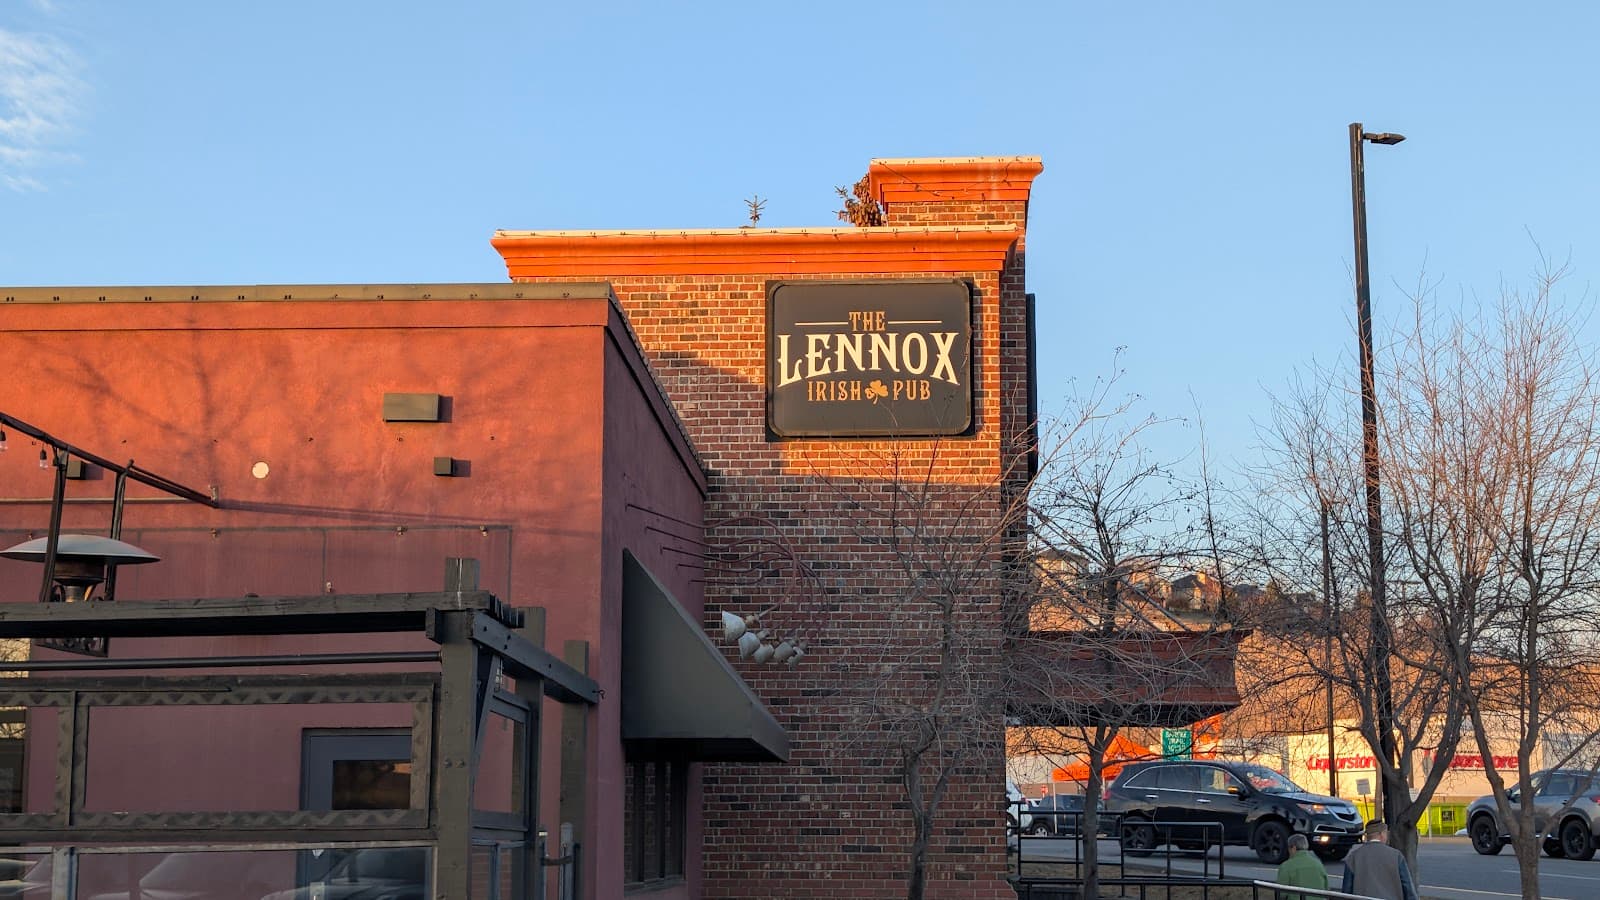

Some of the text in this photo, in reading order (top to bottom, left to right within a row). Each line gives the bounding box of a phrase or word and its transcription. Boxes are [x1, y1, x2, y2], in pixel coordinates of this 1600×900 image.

[848, 311, 886, 332] THE
[777, 332, 960, 388] LENNOX
[807, 380, 931, 401] IRISH PUB
[1307, 754, 1377, 773] Liqorstor
